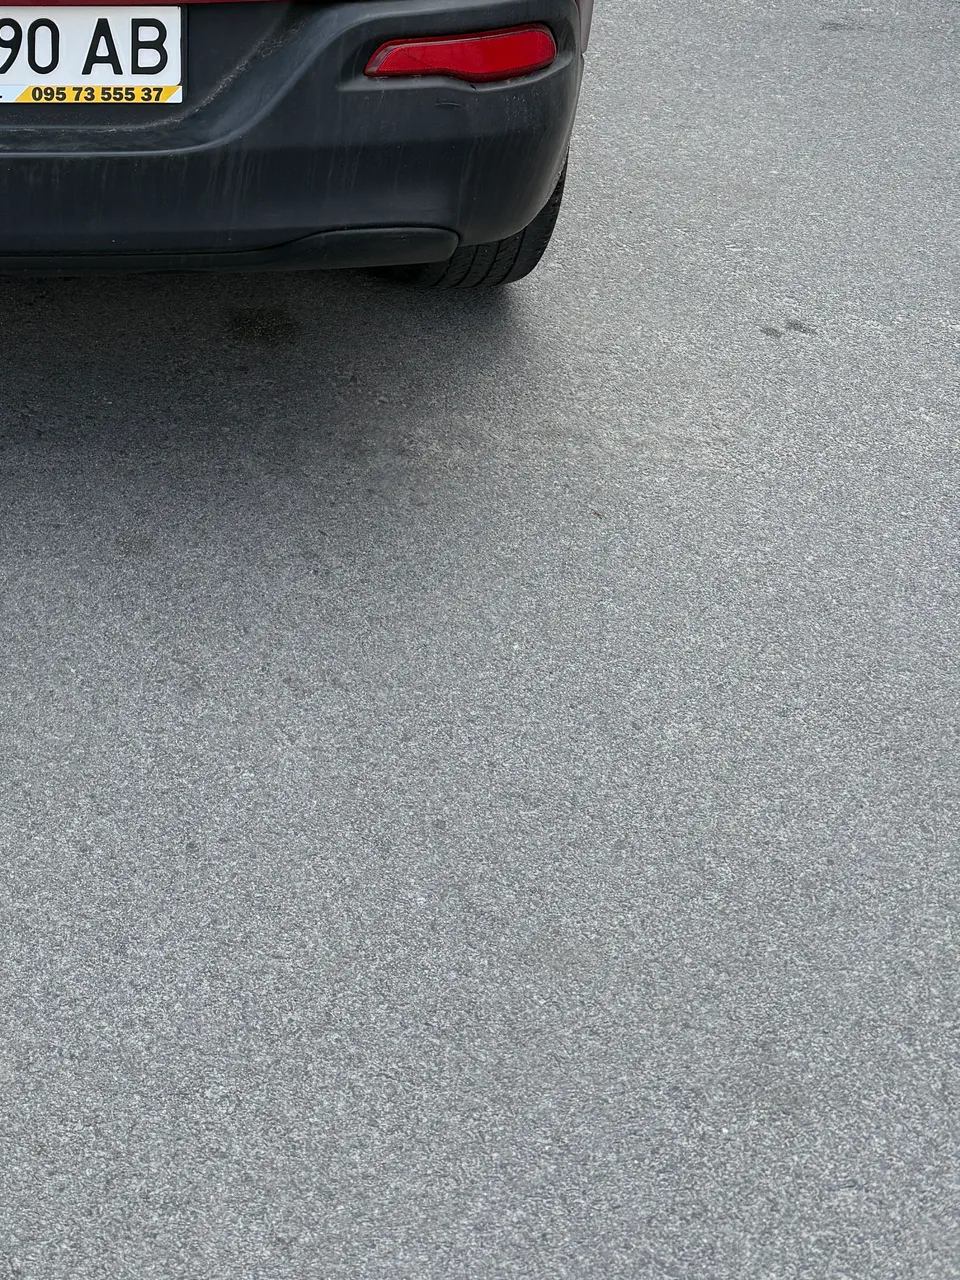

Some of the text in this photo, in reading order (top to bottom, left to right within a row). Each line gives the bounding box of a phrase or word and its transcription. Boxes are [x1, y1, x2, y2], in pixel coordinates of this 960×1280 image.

[81, 17, 169, 75] AB
[31, 86, 164, 102] 095 73 555 37
